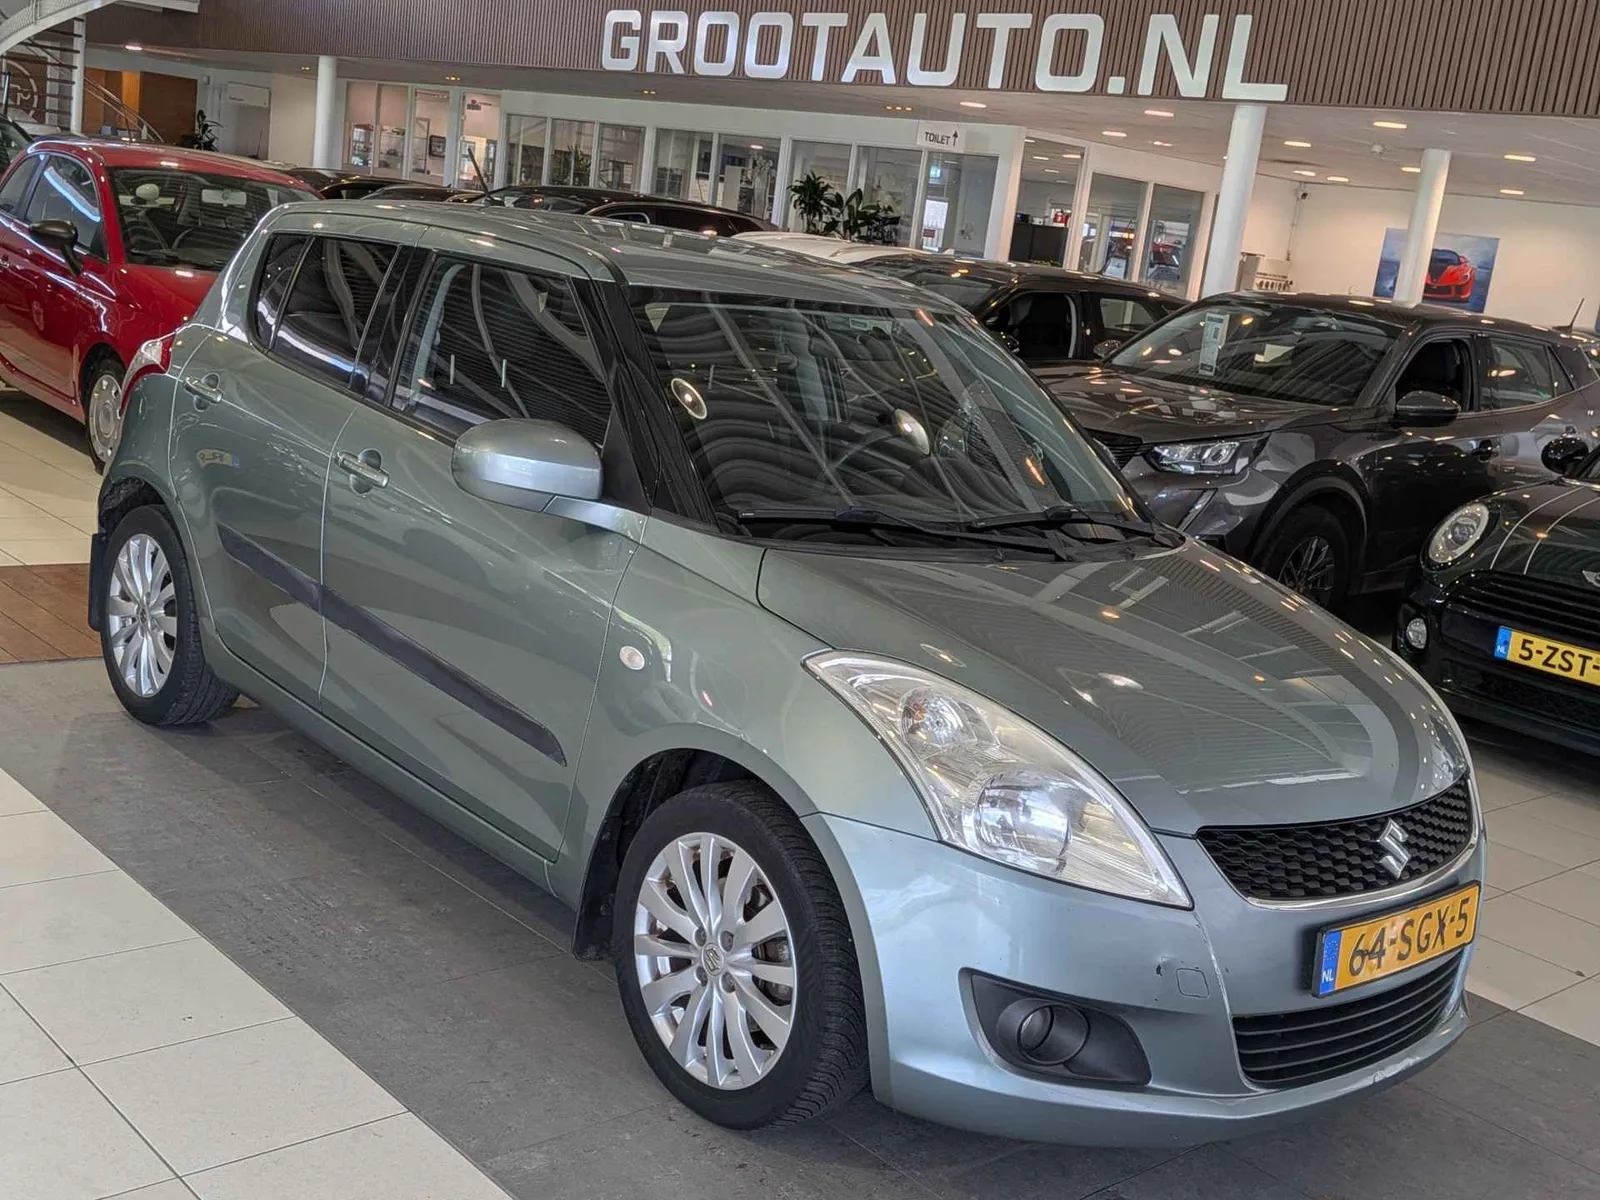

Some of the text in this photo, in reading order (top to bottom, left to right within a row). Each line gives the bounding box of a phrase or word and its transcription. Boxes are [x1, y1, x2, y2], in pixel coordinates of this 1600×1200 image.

[601, 10, 1288, 102] GROOTAUTO.NL
[924, 131, 951, 145] TOILET
[1519, 638, 1600, 677] 5-ZST-
[1349, 897, 1470, 977] 64-SGX-5
[1321, 969, 1334, 984] NL
